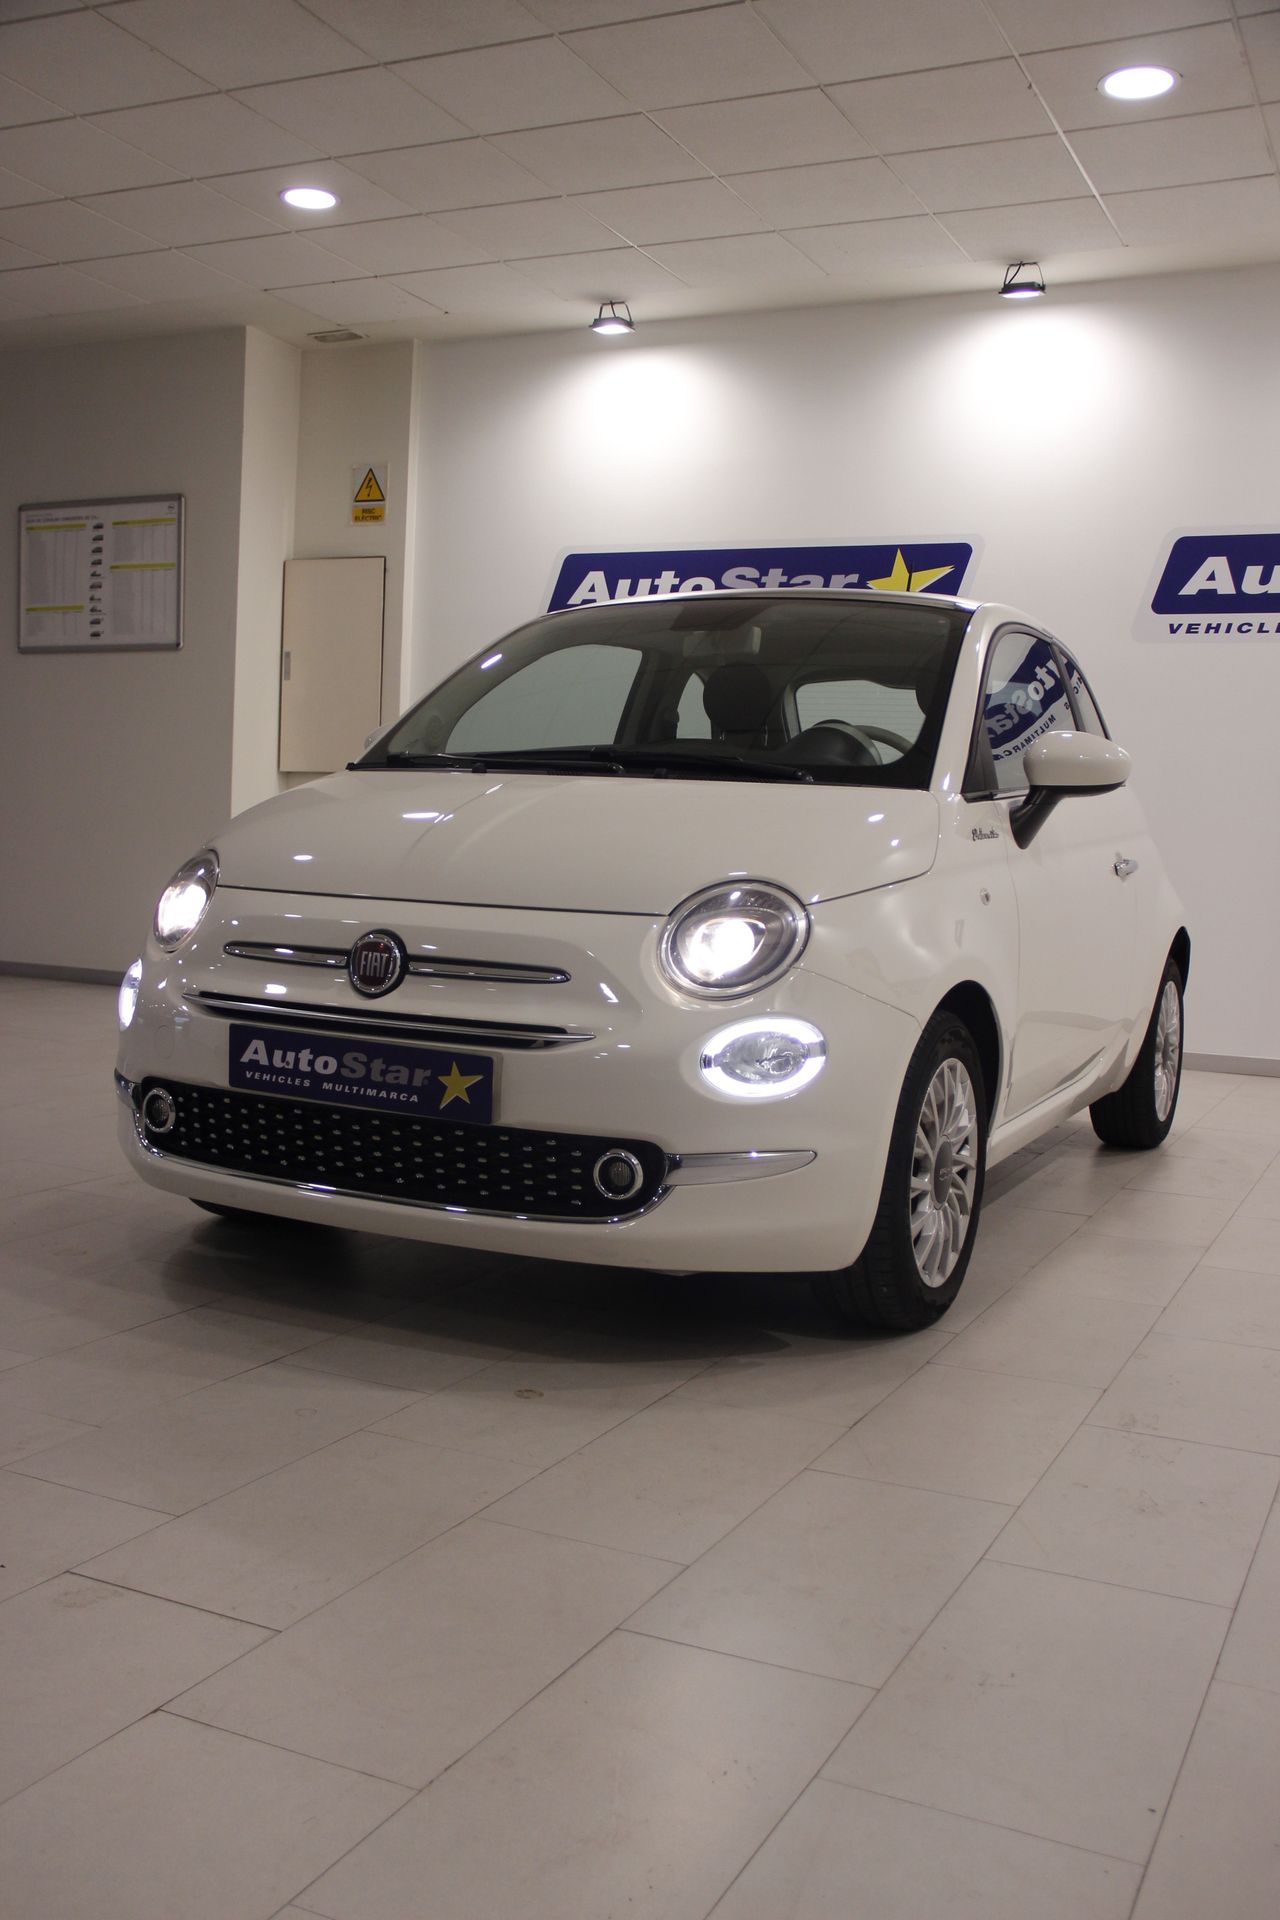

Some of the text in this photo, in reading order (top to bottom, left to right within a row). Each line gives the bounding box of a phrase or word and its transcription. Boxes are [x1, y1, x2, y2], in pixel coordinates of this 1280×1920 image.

[360, 951, 389, 977] FIAT
[239, 1039, 432, 1087] AutoStar
[245, 1070, 419, 1102] VEHICLES MULTIMARCA
